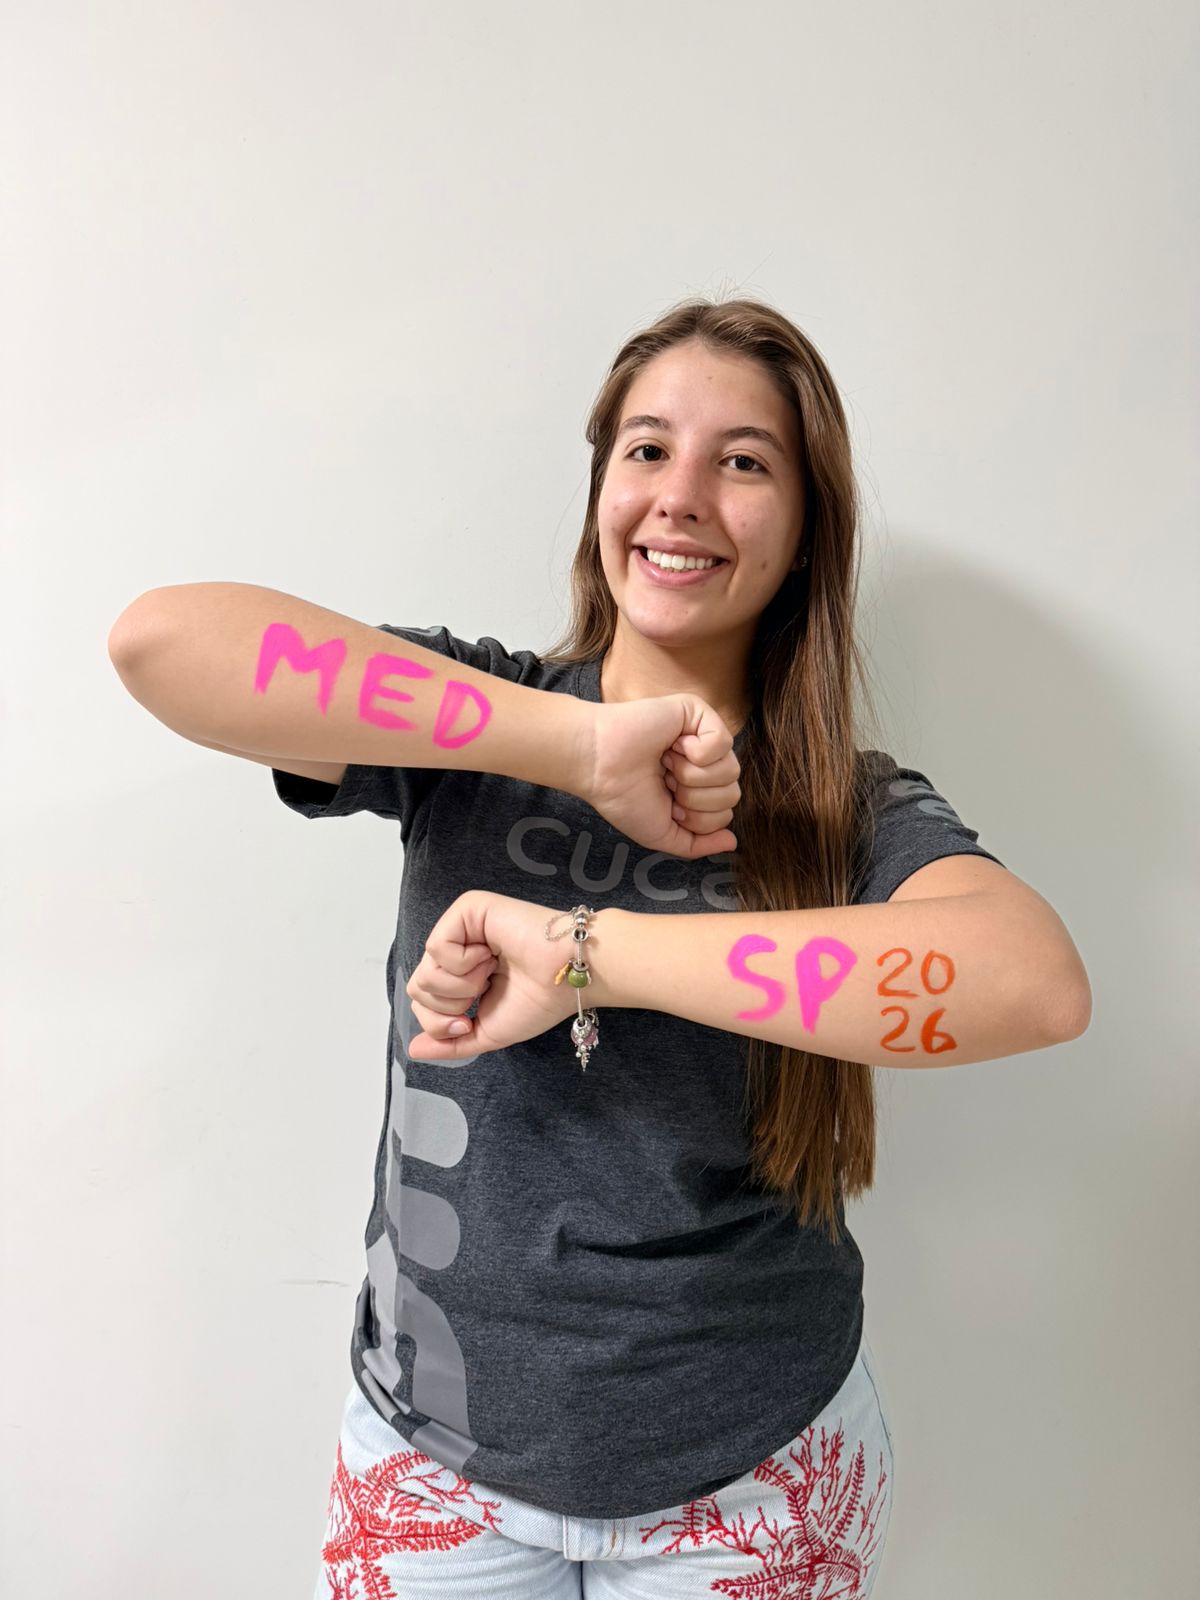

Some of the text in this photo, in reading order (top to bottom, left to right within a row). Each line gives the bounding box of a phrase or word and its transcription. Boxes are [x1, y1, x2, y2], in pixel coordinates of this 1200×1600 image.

[254, 623, 492, 750] MED
[727, 934, 858, 1035] SP
[876, 947, 955, 998] 20
[880, 1005, 957, 1054] 26
